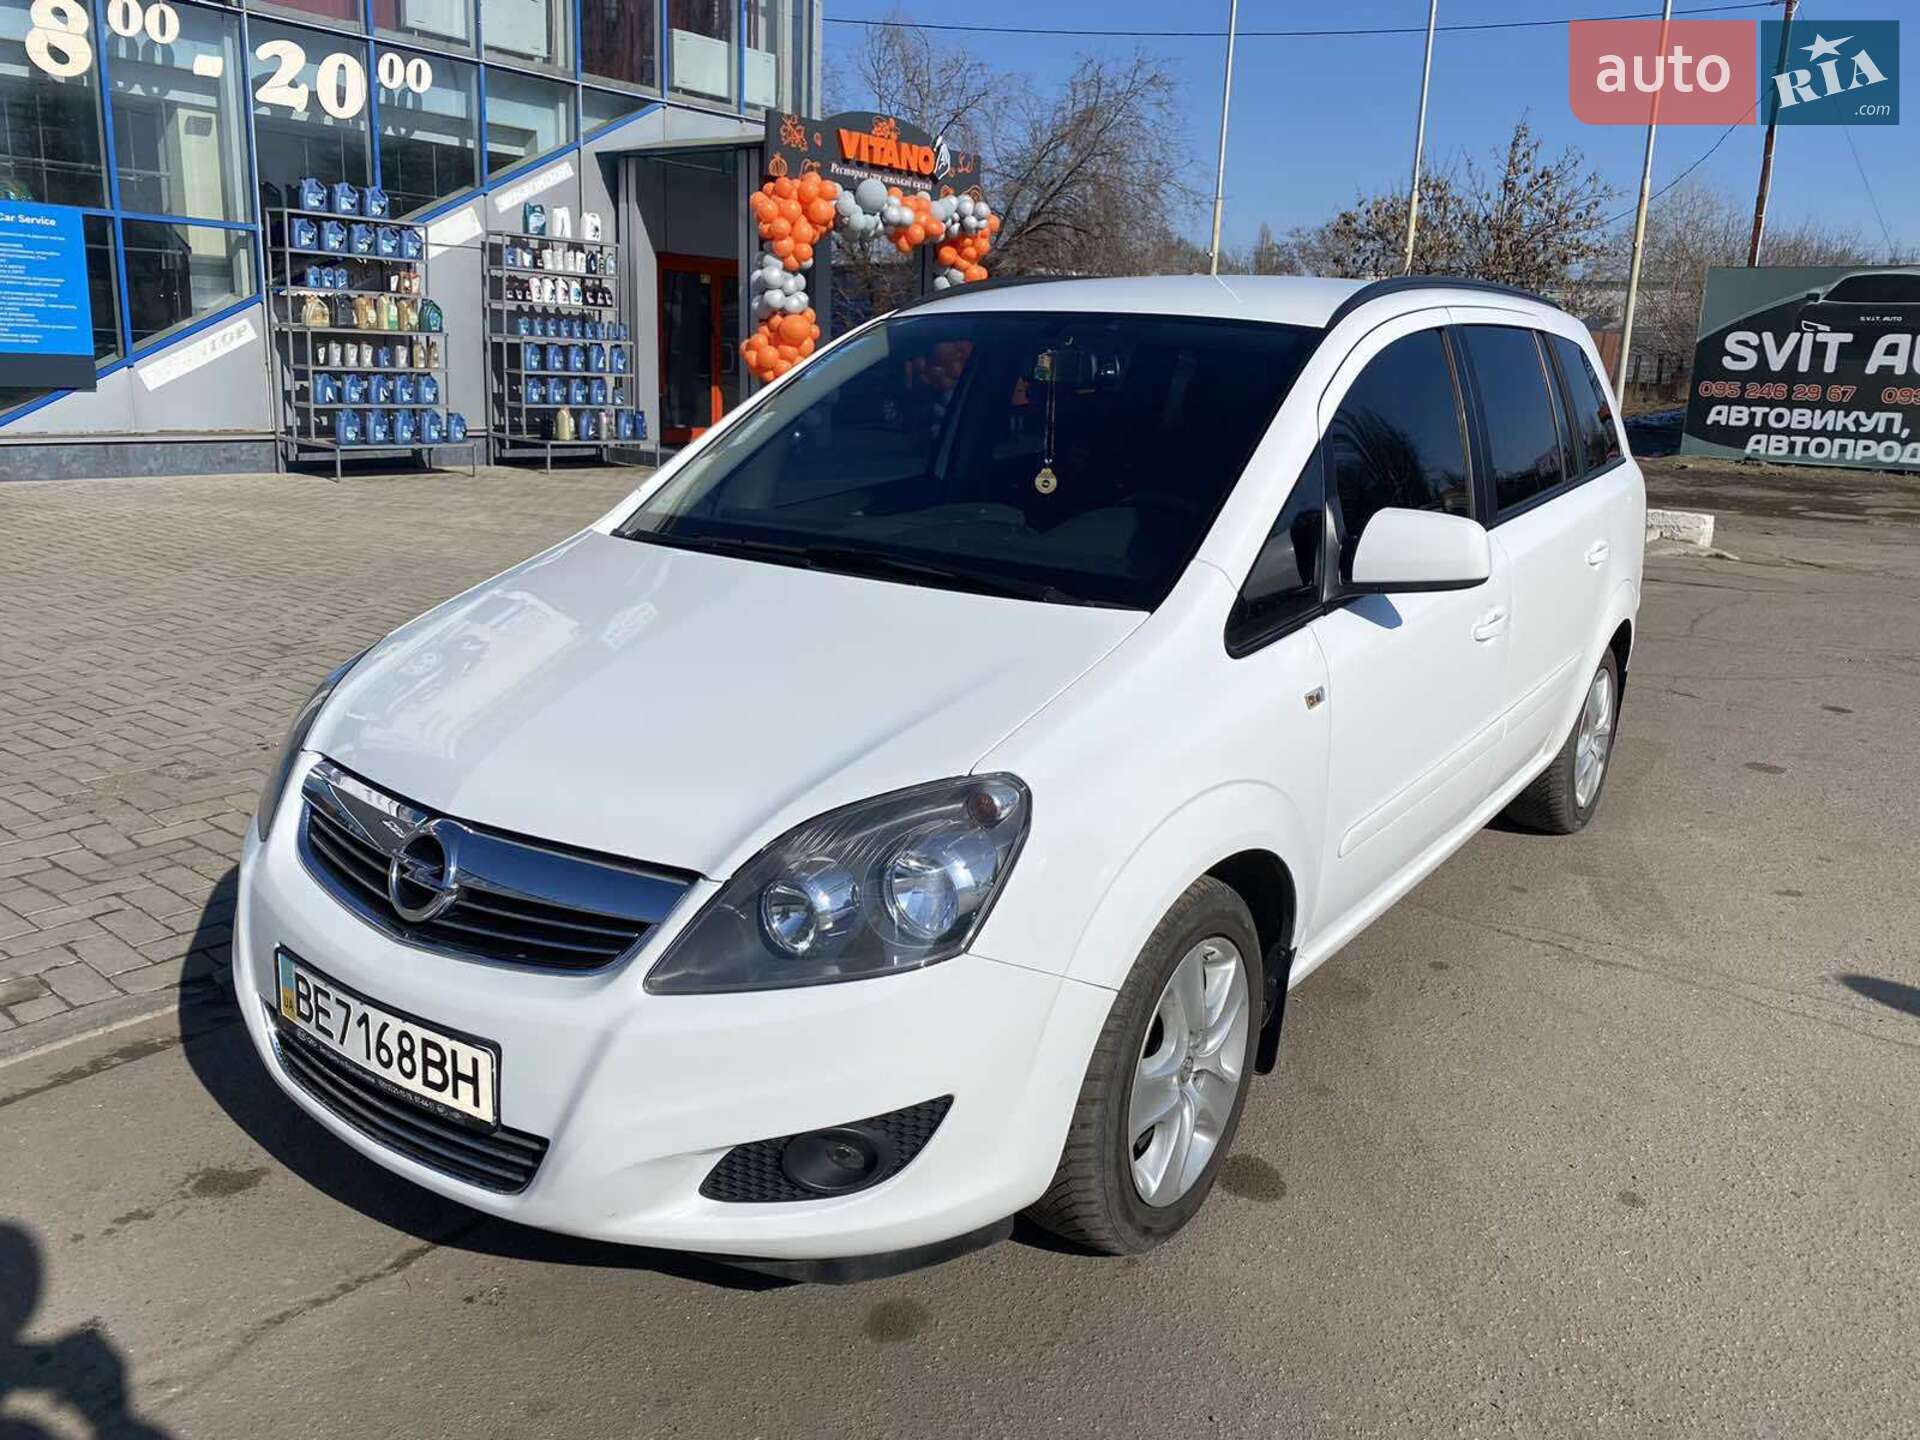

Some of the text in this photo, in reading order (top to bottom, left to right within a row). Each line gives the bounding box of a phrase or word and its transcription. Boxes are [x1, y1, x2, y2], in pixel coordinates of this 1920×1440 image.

[25, 0, 92, 77] 8
[838, 128, 935, 176] VITANO
[17, 214, 56, 226] Service
[1865, 333, 1920, 375] A
[1699, 381, 1741, 397] 095
[1745, 382, 1787, 400] 246
[1792, 384, 1821, 401] 29
[1827, 385, 1856, 402] 67
[1706, 405, 1910, 438] АВТОВИКУП,
[294, 972, 480, 1108] BE7168BH
